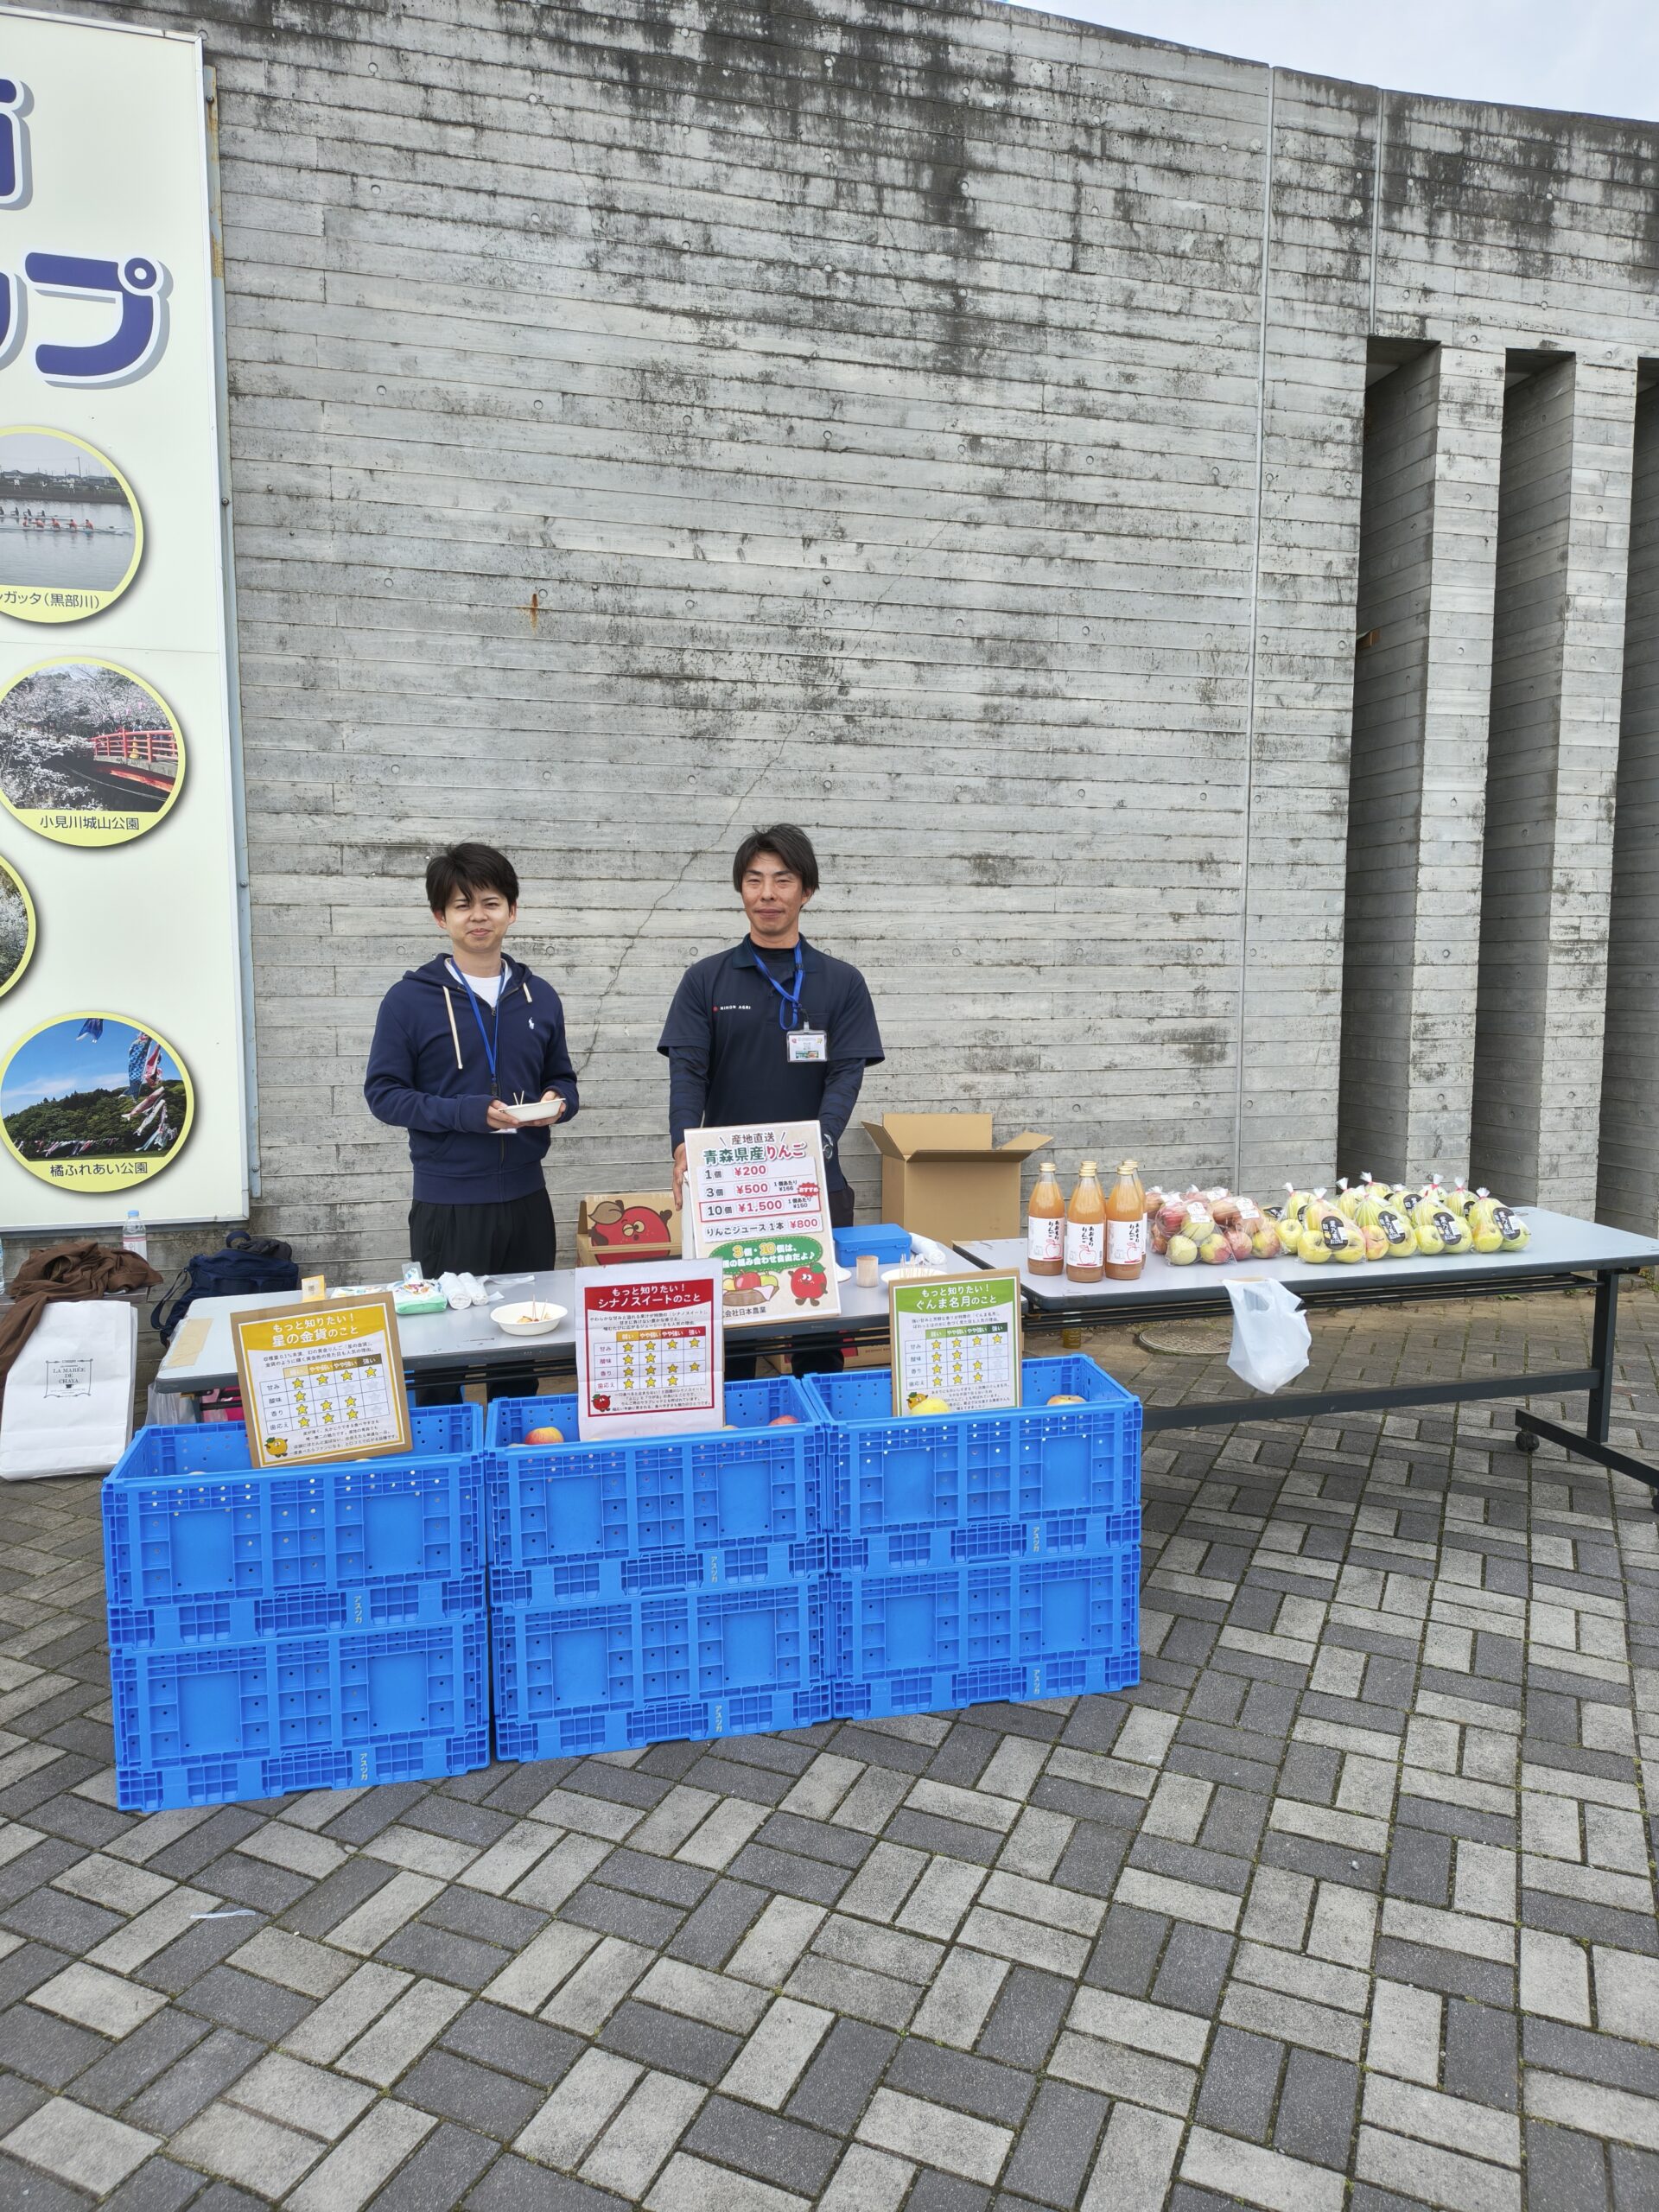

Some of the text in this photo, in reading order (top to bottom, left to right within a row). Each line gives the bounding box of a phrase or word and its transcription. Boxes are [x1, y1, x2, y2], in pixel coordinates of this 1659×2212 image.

[40, 815, 139, 830] 小見川城山公園
[732, 1132, 775, 1145] 産地直送
[702, 1143, 806, 1165] 青森県産りんご
[50, 1162, 148, 1178] 橘ふれあい公園
[734, 1165, 766, 1176] ¥200
[736, 1184, 768, 1194] ¥500
[738, 1200, 782, 1213] ¥1,500
[790, 1218, 817, 1229] ¥800
[598, 1294, 702, 1308] シナノスイートのこと
[916, 1294, 997, 1310] ぐんま名月のこと
[271, 1325, 359, 1348] 星の金貨のこと
[270, 1422, 289, 1431] 歯応え
